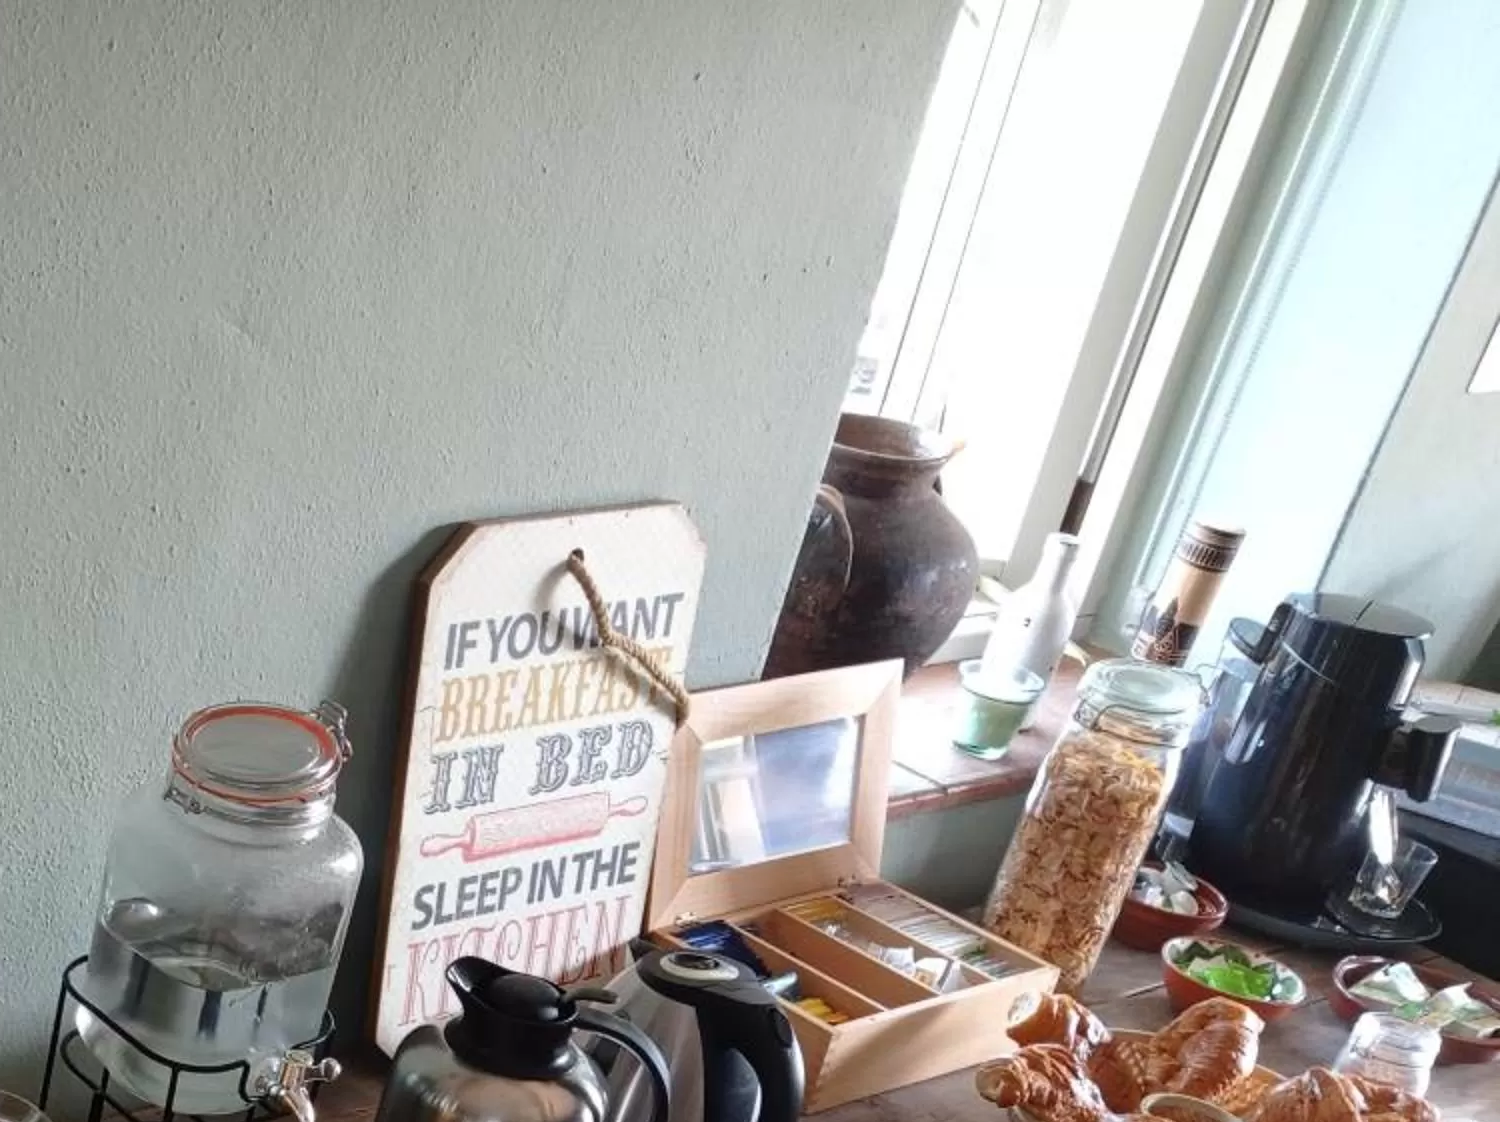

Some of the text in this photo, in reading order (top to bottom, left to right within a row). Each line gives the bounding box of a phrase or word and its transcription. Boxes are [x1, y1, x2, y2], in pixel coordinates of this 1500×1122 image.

[444, 592, 684, 671] IF YOU WANT
[424, 718, 654, 814] IN BED
[411, 841, 641, 931] SLEEP IN THE
